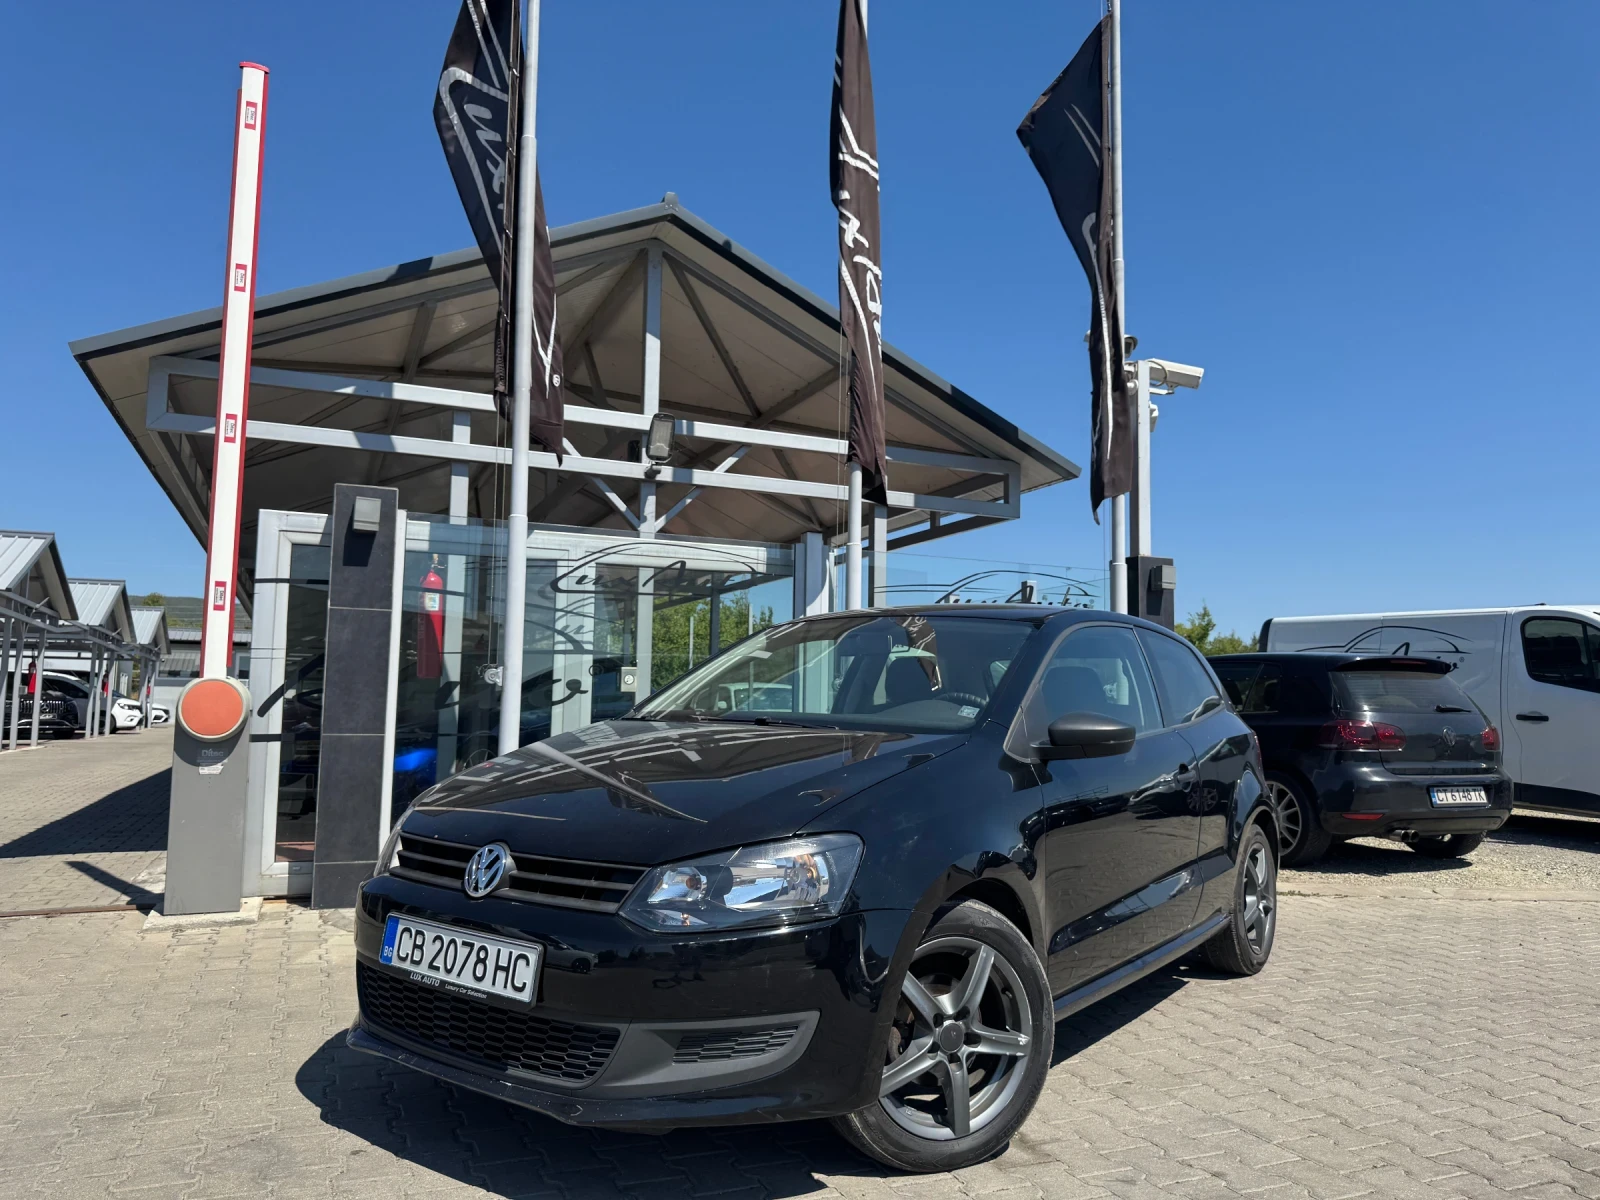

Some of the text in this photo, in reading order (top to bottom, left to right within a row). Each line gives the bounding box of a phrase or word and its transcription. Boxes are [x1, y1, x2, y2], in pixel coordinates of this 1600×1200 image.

[383, 945, 393, 957] BG
[397, 926, 531, 993] CB 2078 HC
[409, 971, 440, 987] LUX AUTO
[444, 983, 459, 993] Luxury
[467, 988, 488, 999] Selection
